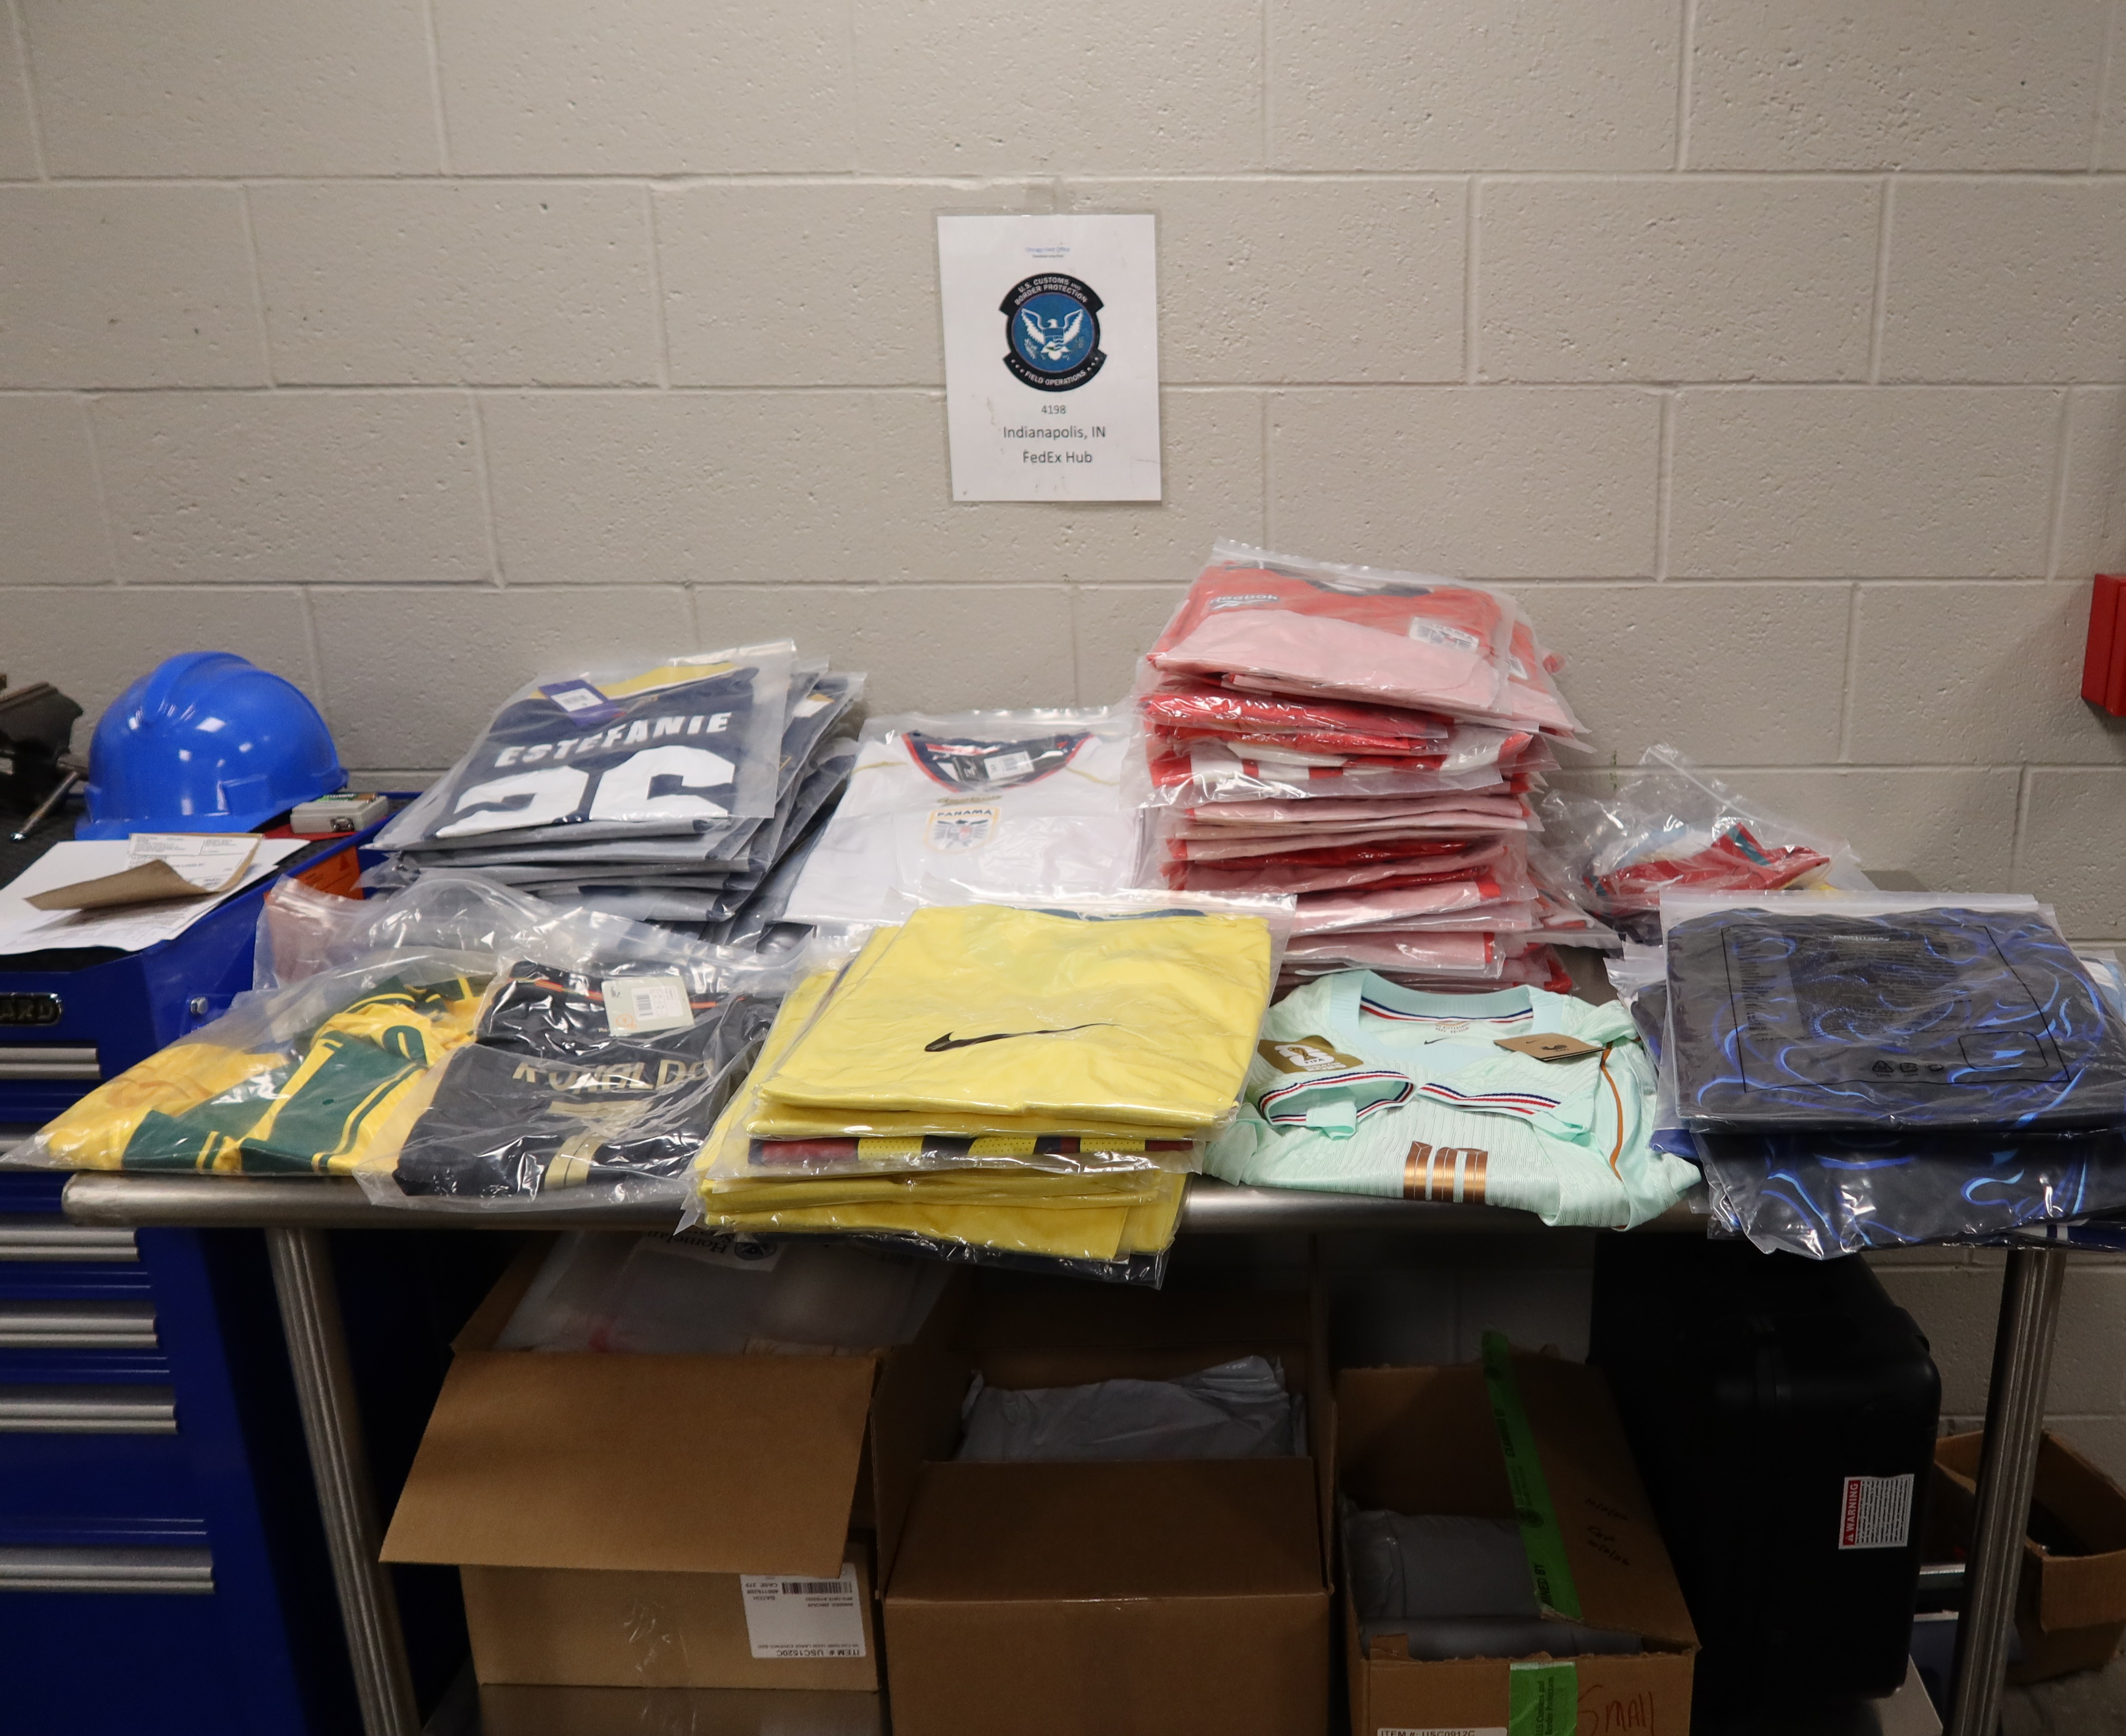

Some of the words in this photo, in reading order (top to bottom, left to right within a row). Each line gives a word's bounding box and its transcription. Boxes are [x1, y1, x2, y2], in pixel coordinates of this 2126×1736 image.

[1018, 282, 1032, 293] U.S.
[1033, 276, 1070, 286] CUSTOMS
[1014, 285, 1042, 306] BORDER
[1043, 284, 1088, 303] PROTECTION
[1024, 370, 1043, 384] FIELD
[1044, 369, 1086, 386] OPERATIONS
[1041, 404, 1066, 414] 4198
[1004, 425, 1087, 440] Indianapolis,
[1092, 426, 1106, 437] IN
[1023, 451, 1062, 463] FedEx
[1065, 451, 1093, 463] Hub
[493, 712, 732, 767] ESTEFANIE
[937, 809, 992, 817] PANAMA
[648, 1231, 728, 1254] Homelan
[1496, 1419, 1516, 1457] EXAMINED
[1846, 1483, 1858, 1532] WARNING
[1533, 1562, 1545, 1576] BY
